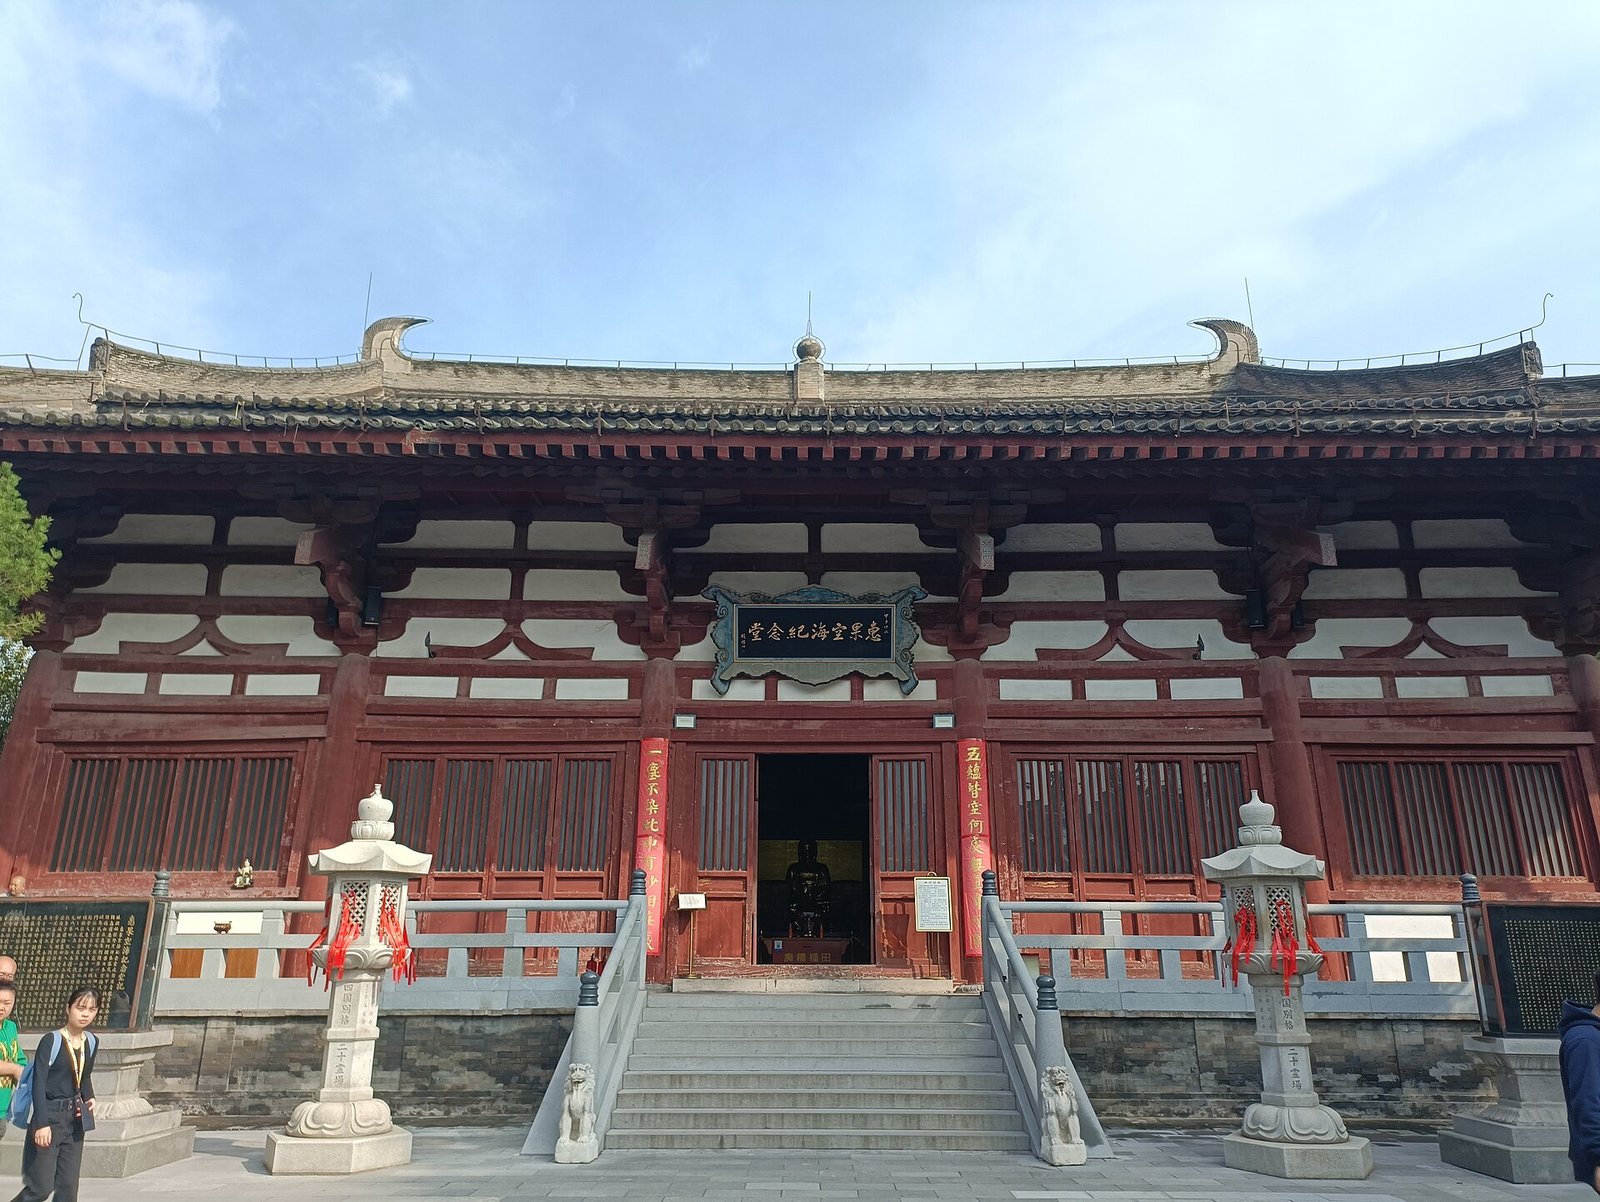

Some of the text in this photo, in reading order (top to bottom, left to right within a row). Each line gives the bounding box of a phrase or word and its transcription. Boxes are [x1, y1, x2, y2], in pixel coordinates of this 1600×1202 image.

[748, 620, 883, 642] 惠果空海紀念堂
